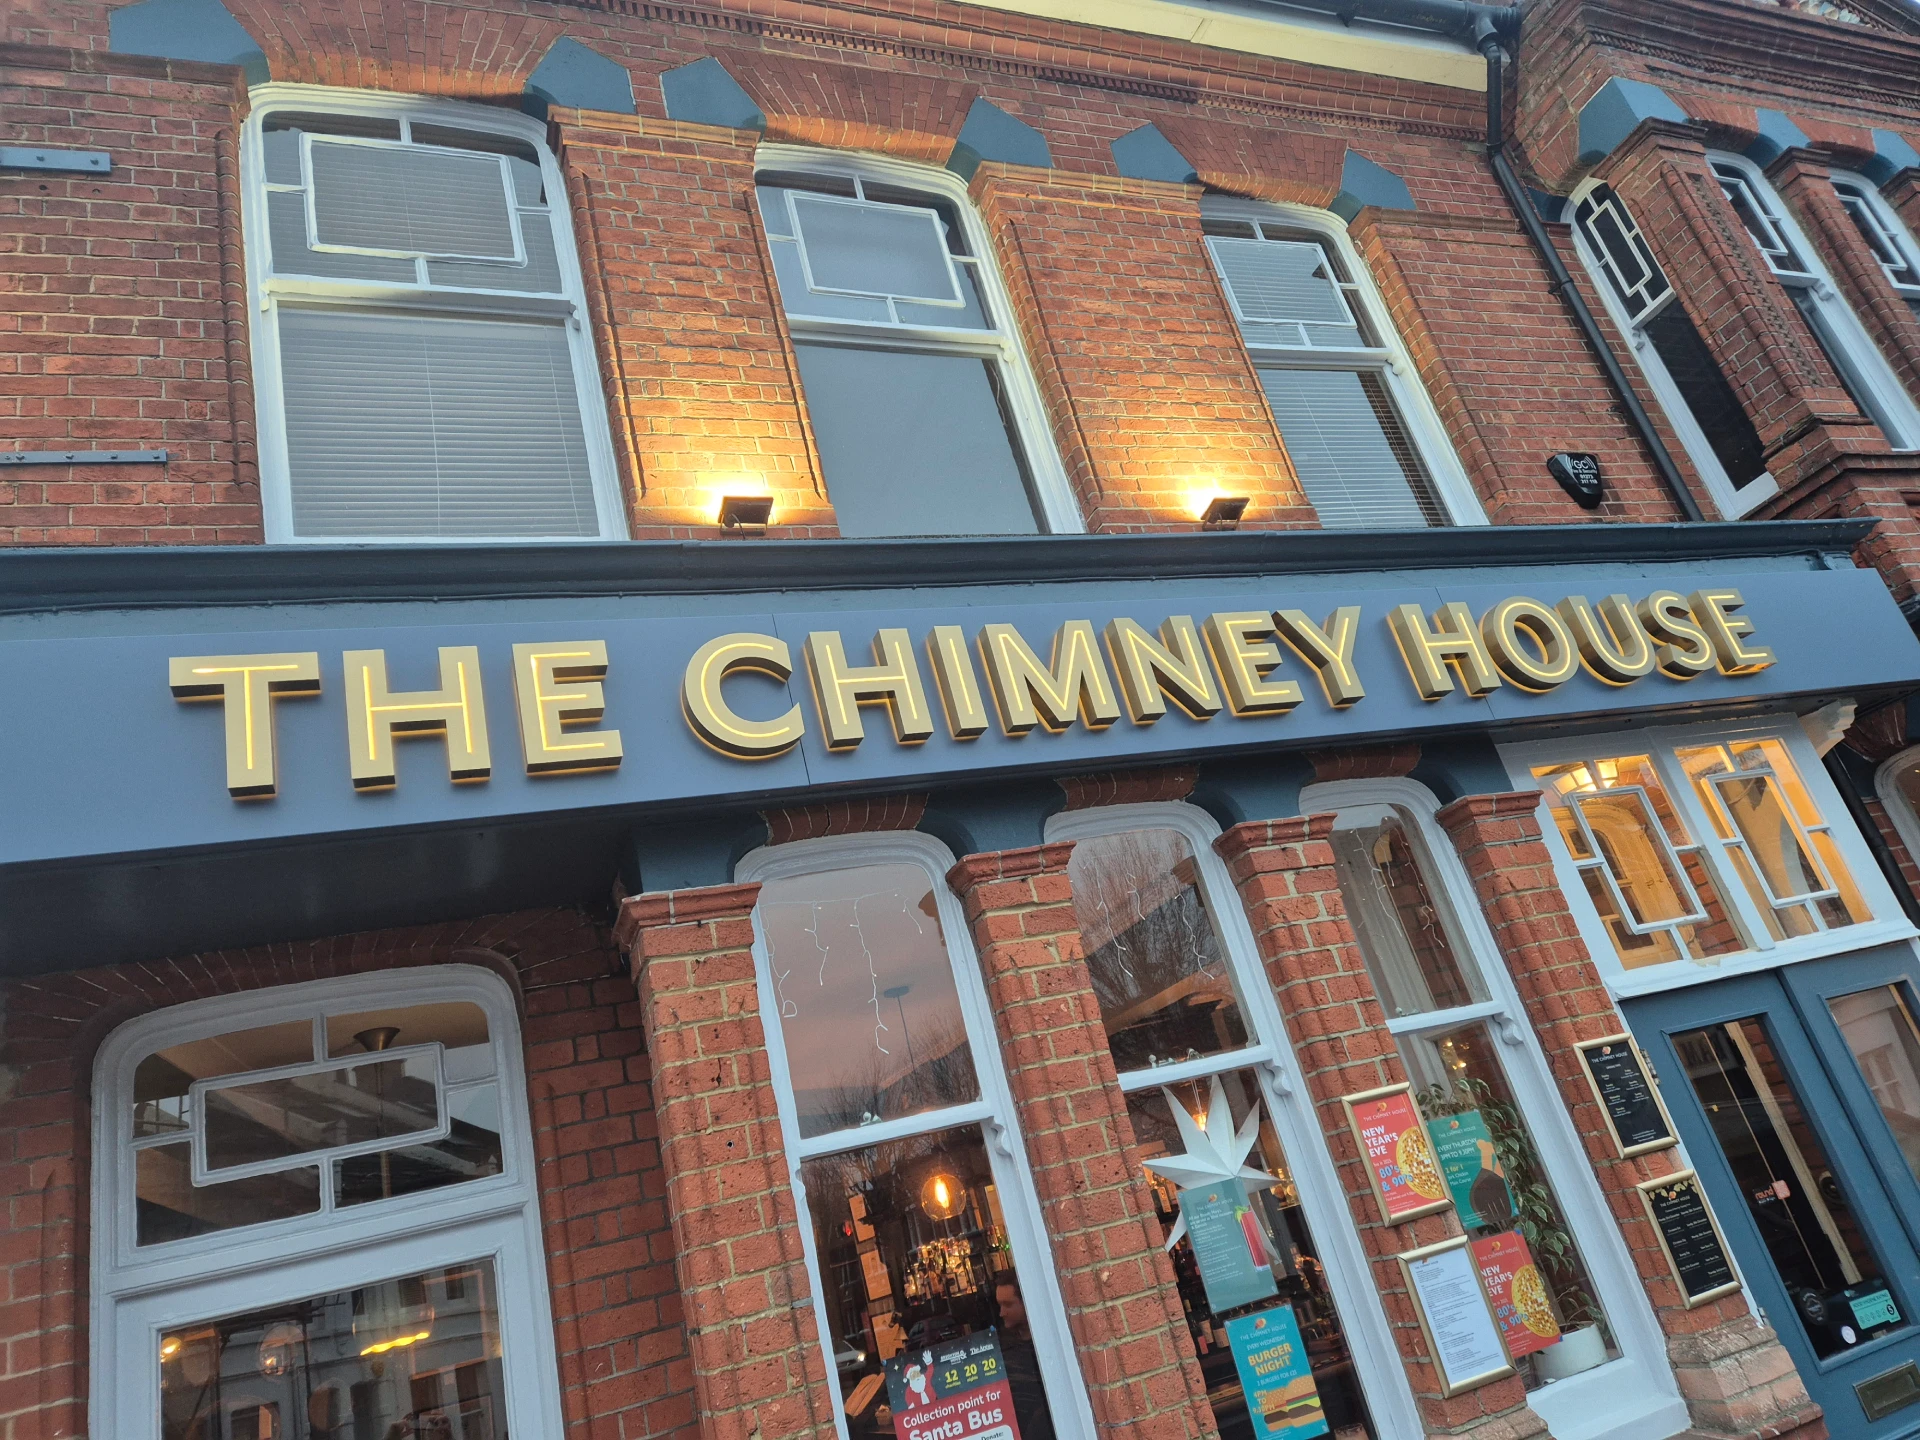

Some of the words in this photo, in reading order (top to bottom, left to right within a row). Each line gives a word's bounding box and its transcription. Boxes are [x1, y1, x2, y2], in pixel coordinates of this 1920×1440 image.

[1573, 460, 1588, 469] GC
[168, 639, 624, 800] THE
[682, 604, 1365, 759] CHIMNEY
[1388, 587, 1776, 700] HOUSE
[1372, 1112, 1391, 1120] CHIMNEY
[1362, 1125, 1384, 1138] NEW
[1365, 1132, 1398, 1148] YEAR'S
[1438, 1144, 1452, 1153] EVERY
[1452, 1138, 1477, 1149] THURSDAY
[1368, 1146, 1388, 1158] EVE
[1379, 1165, 1400, 1178] 80's
[1382, 1182, 1391, 1192] &
[1392, 1174, 1414, 1187] 90's
[1480, 1264, 1500, 1277] NEW
[1484, 1272, 1513, 1287] YEAR'S
[1488, 1286, 1504, 1297] EVE
[1497, 1304, 1516, 1318] 80's
[1500, 1321, 1508, 1332] &
[1510, 1313, 1529, 1326] 90's
[1250, 1329, 1270, 1338] CHIMNEY
[1272, 1324, 1287, 1332] HOUSE
[1246, 1342, 1259, 1350] EVERY
[1260, 1335, 1286, 1347] WEDNESDAY
[1248, 1342, 1292, 1366] BURGER
[945, 1370, 958, 1382] 12
[964, 1364, 978, 1376] 20
[982, 1358, 996, 1371] 20
[1255, 1355, 1292, 1376] NIGHT
[1260, 1375, 1280, 1386] BURGERS
[903, 1406, 955, 1429] Collection
[957, 1395, 984, 1414] point
[986, 1390, 1001, 1402] for
[910, 1421, 964, 1440] Santa
[968, 1408, 1003, 1430] Bus
